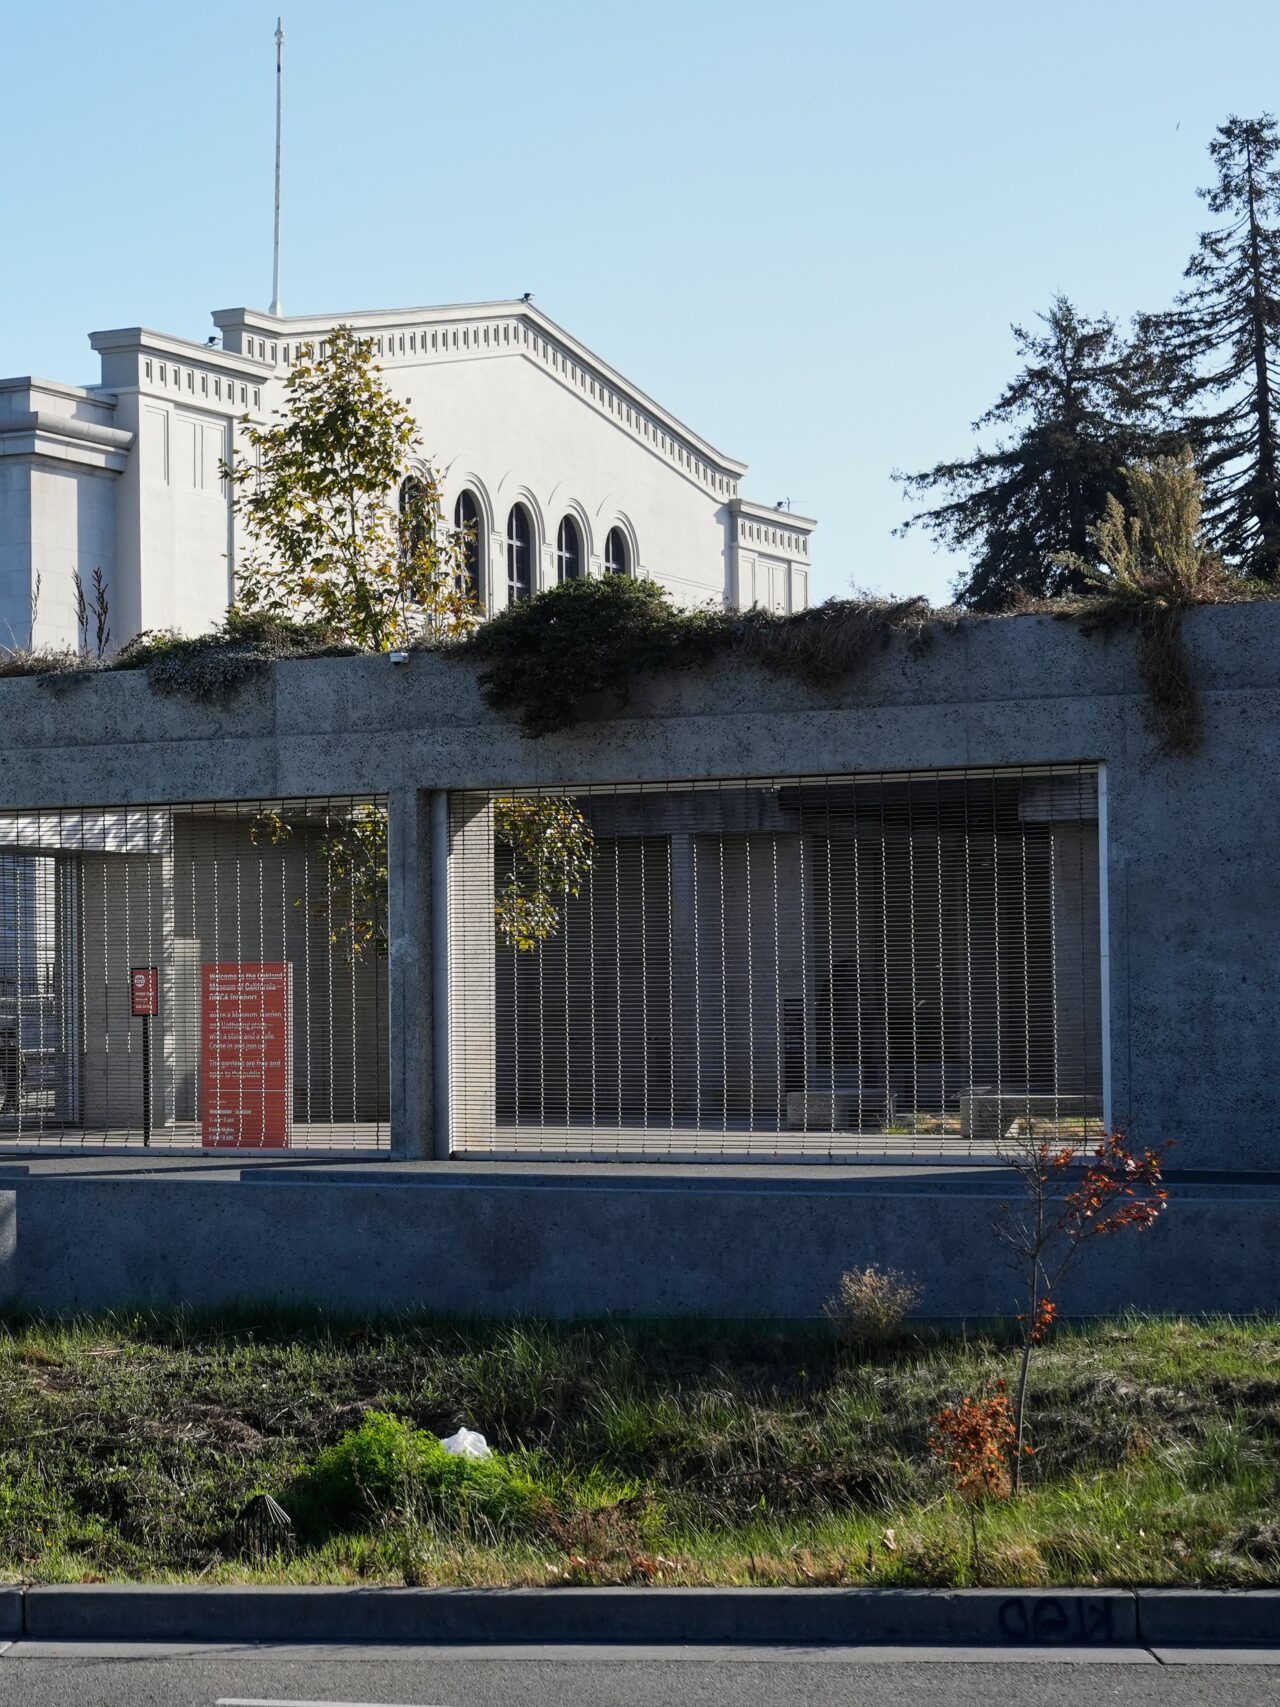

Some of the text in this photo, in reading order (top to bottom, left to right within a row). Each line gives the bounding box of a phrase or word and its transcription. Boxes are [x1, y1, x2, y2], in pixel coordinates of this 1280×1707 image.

[257, 972, 283, 980] Okland
[209, 983, 236, 991] Mseum
[209, 1059, 220, 1067] Th
[221, 1059, 245, 1069] gardes
[256, 1059, 269, 1067] fre
[209, 1071, 224, 1079] opn
[231, 1070, 242, 1078] th
